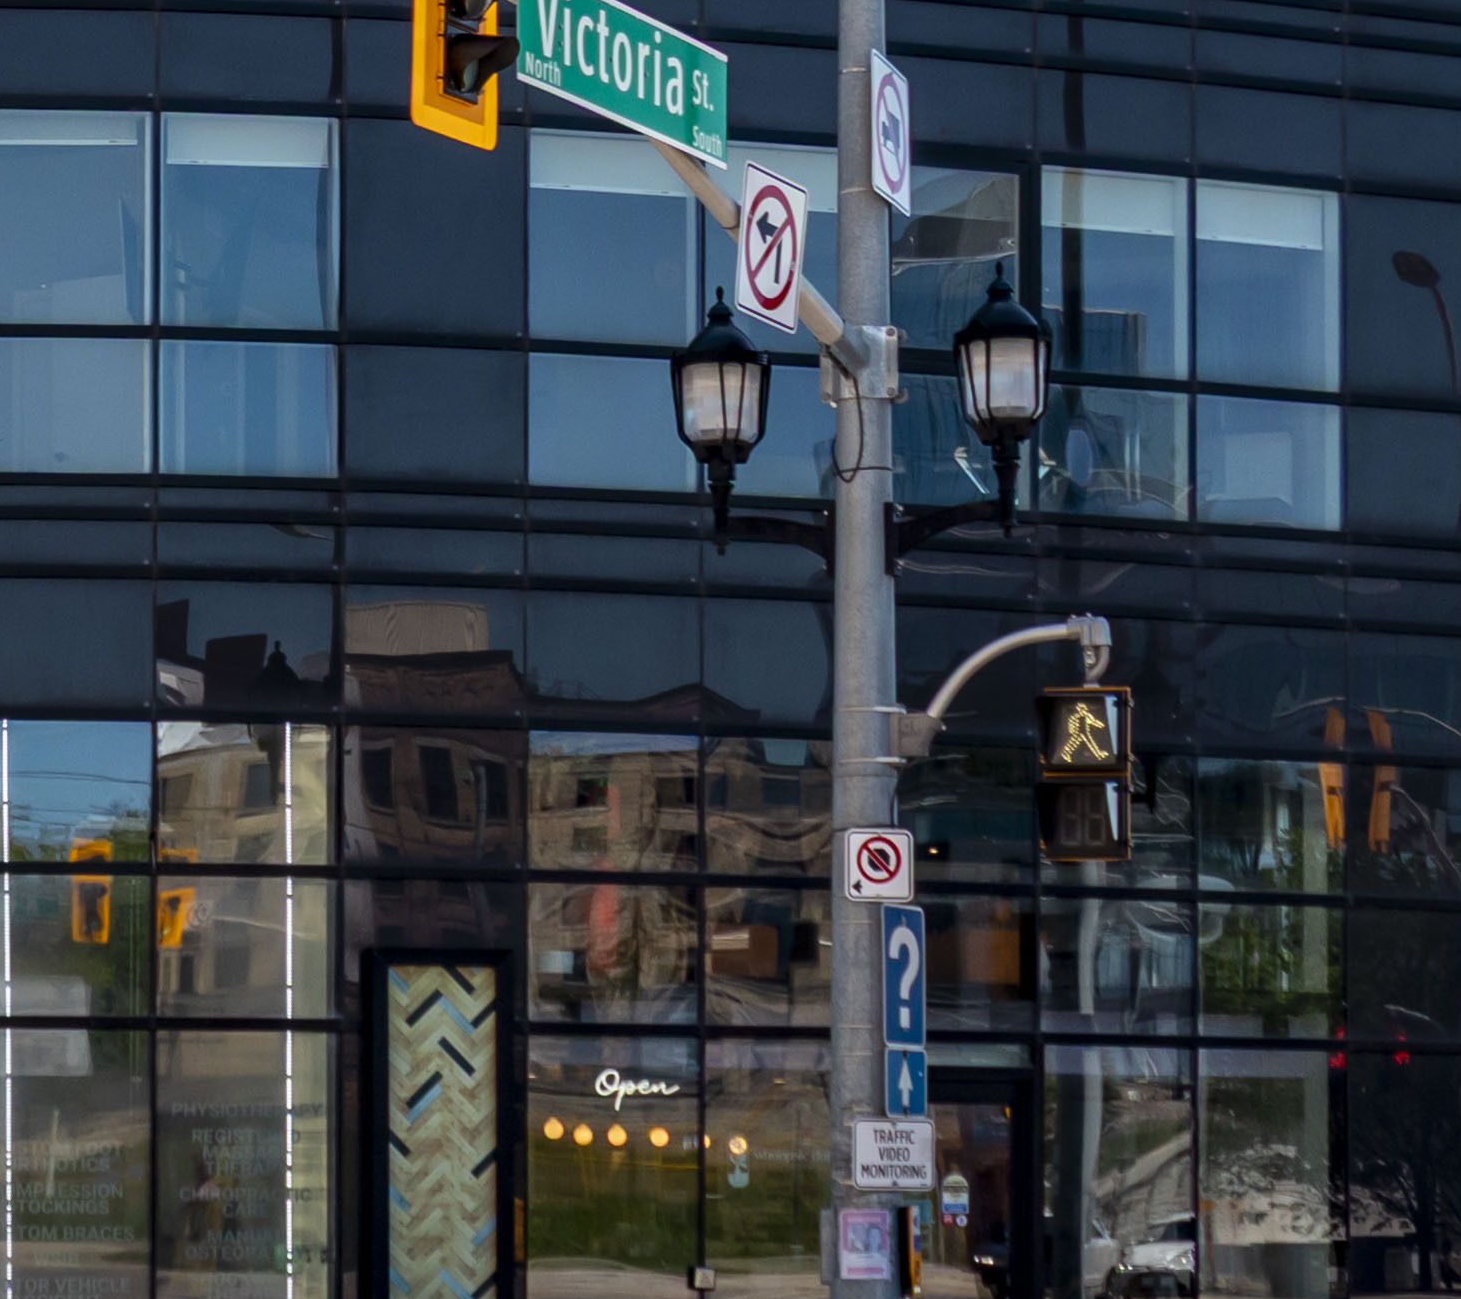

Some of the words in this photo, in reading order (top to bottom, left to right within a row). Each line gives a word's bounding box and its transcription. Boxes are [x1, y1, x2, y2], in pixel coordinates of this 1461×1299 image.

[525, 51, 562, 87] North
[692, 124, 723, 159] South
[594, 1068, 680, 1112] Open
[872, 1129, 916, 1145] TRAFFIC
[878, 1146, 911, 1162] VIDEO
[860, 1164, 928, 1179] MONITORING
[18, 1198, 110, 1214] TOCKINGS
[62, 1225, 136, 1241] BRACES
[54, 1277, 129, 1294] VEHICLE
